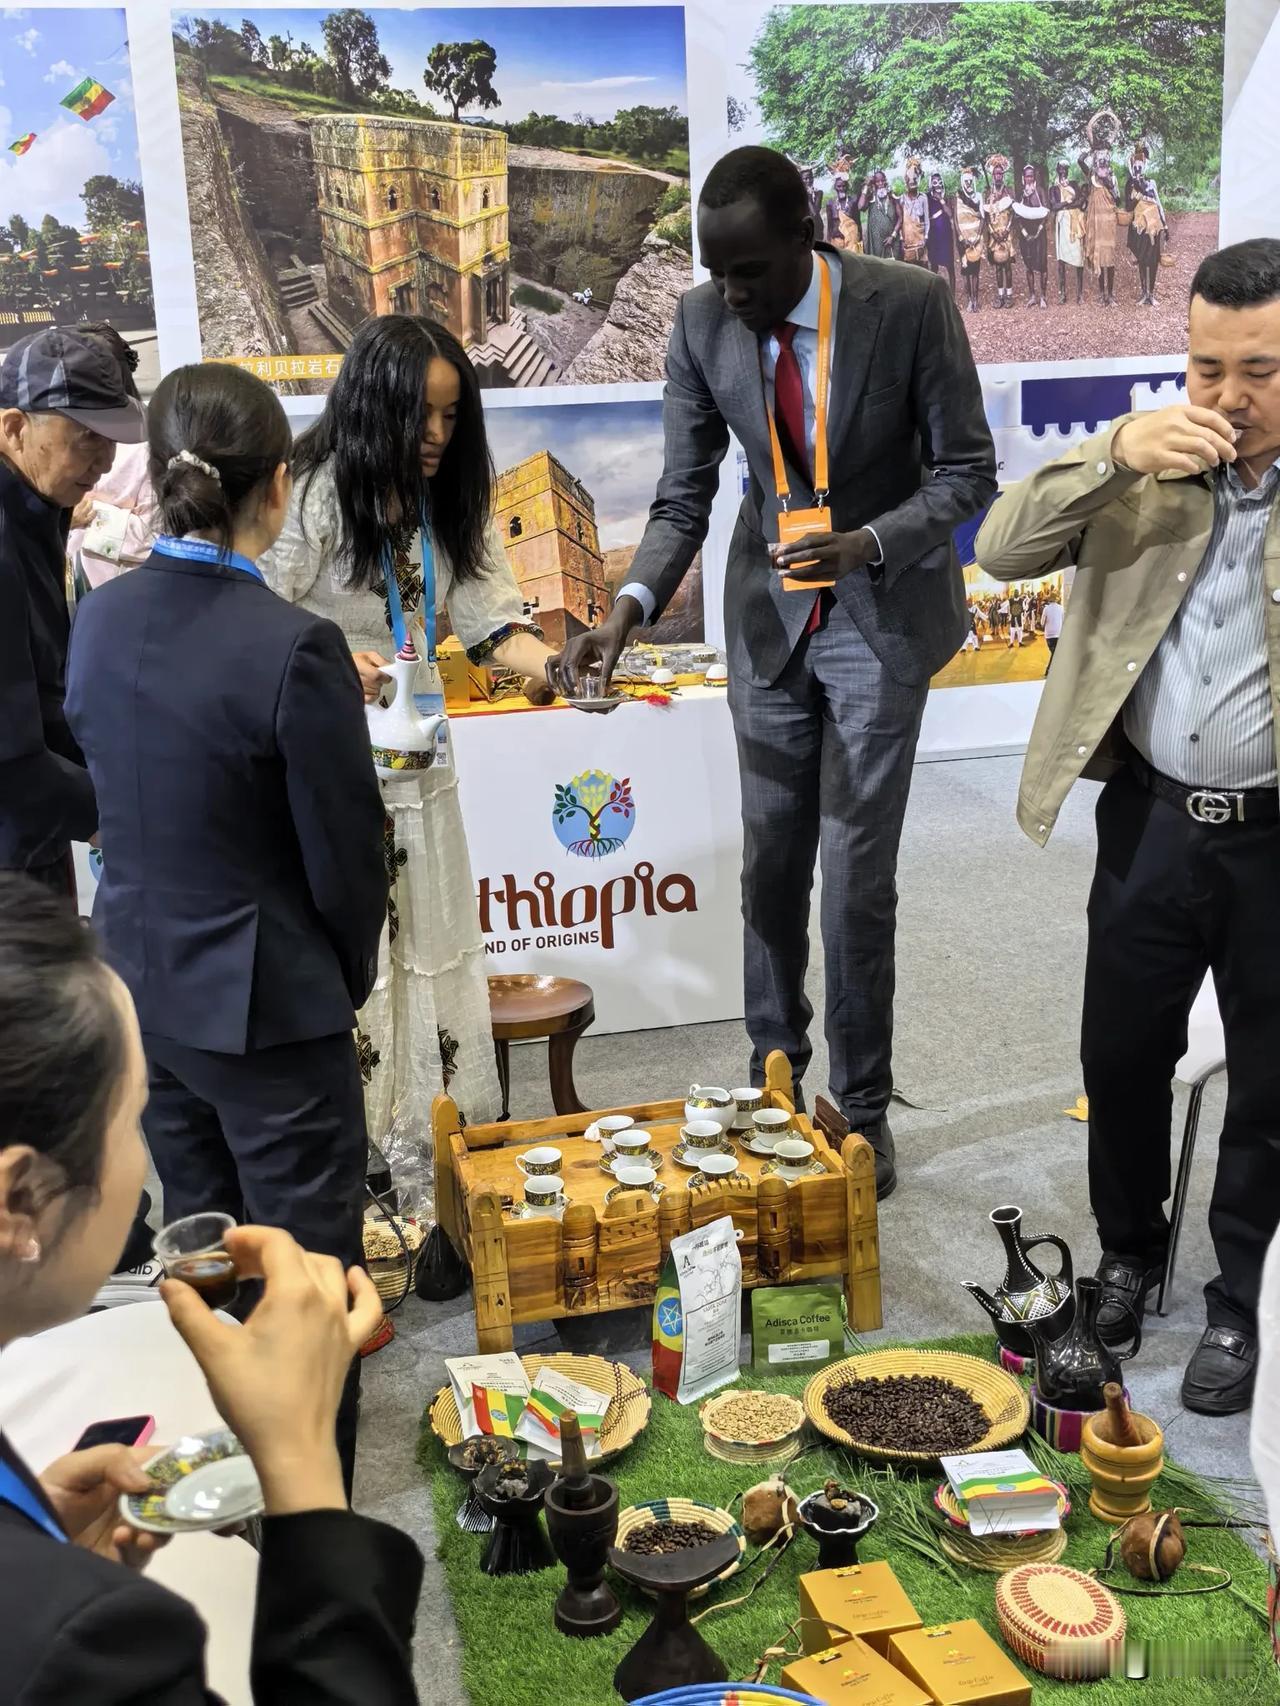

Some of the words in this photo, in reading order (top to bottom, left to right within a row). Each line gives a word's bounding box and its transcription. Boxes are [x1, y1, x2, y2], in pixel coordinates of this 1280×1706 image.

[476, 861, 698, 949] thiopia
[484, 940, 506, 954] ND
[511, 937, 531, 951] OF
[536, 930, 600, 948] ORIGINS
[765, 1317, 798, 1328] Adisca
[799, 1313, 831, 1324] Coffee
